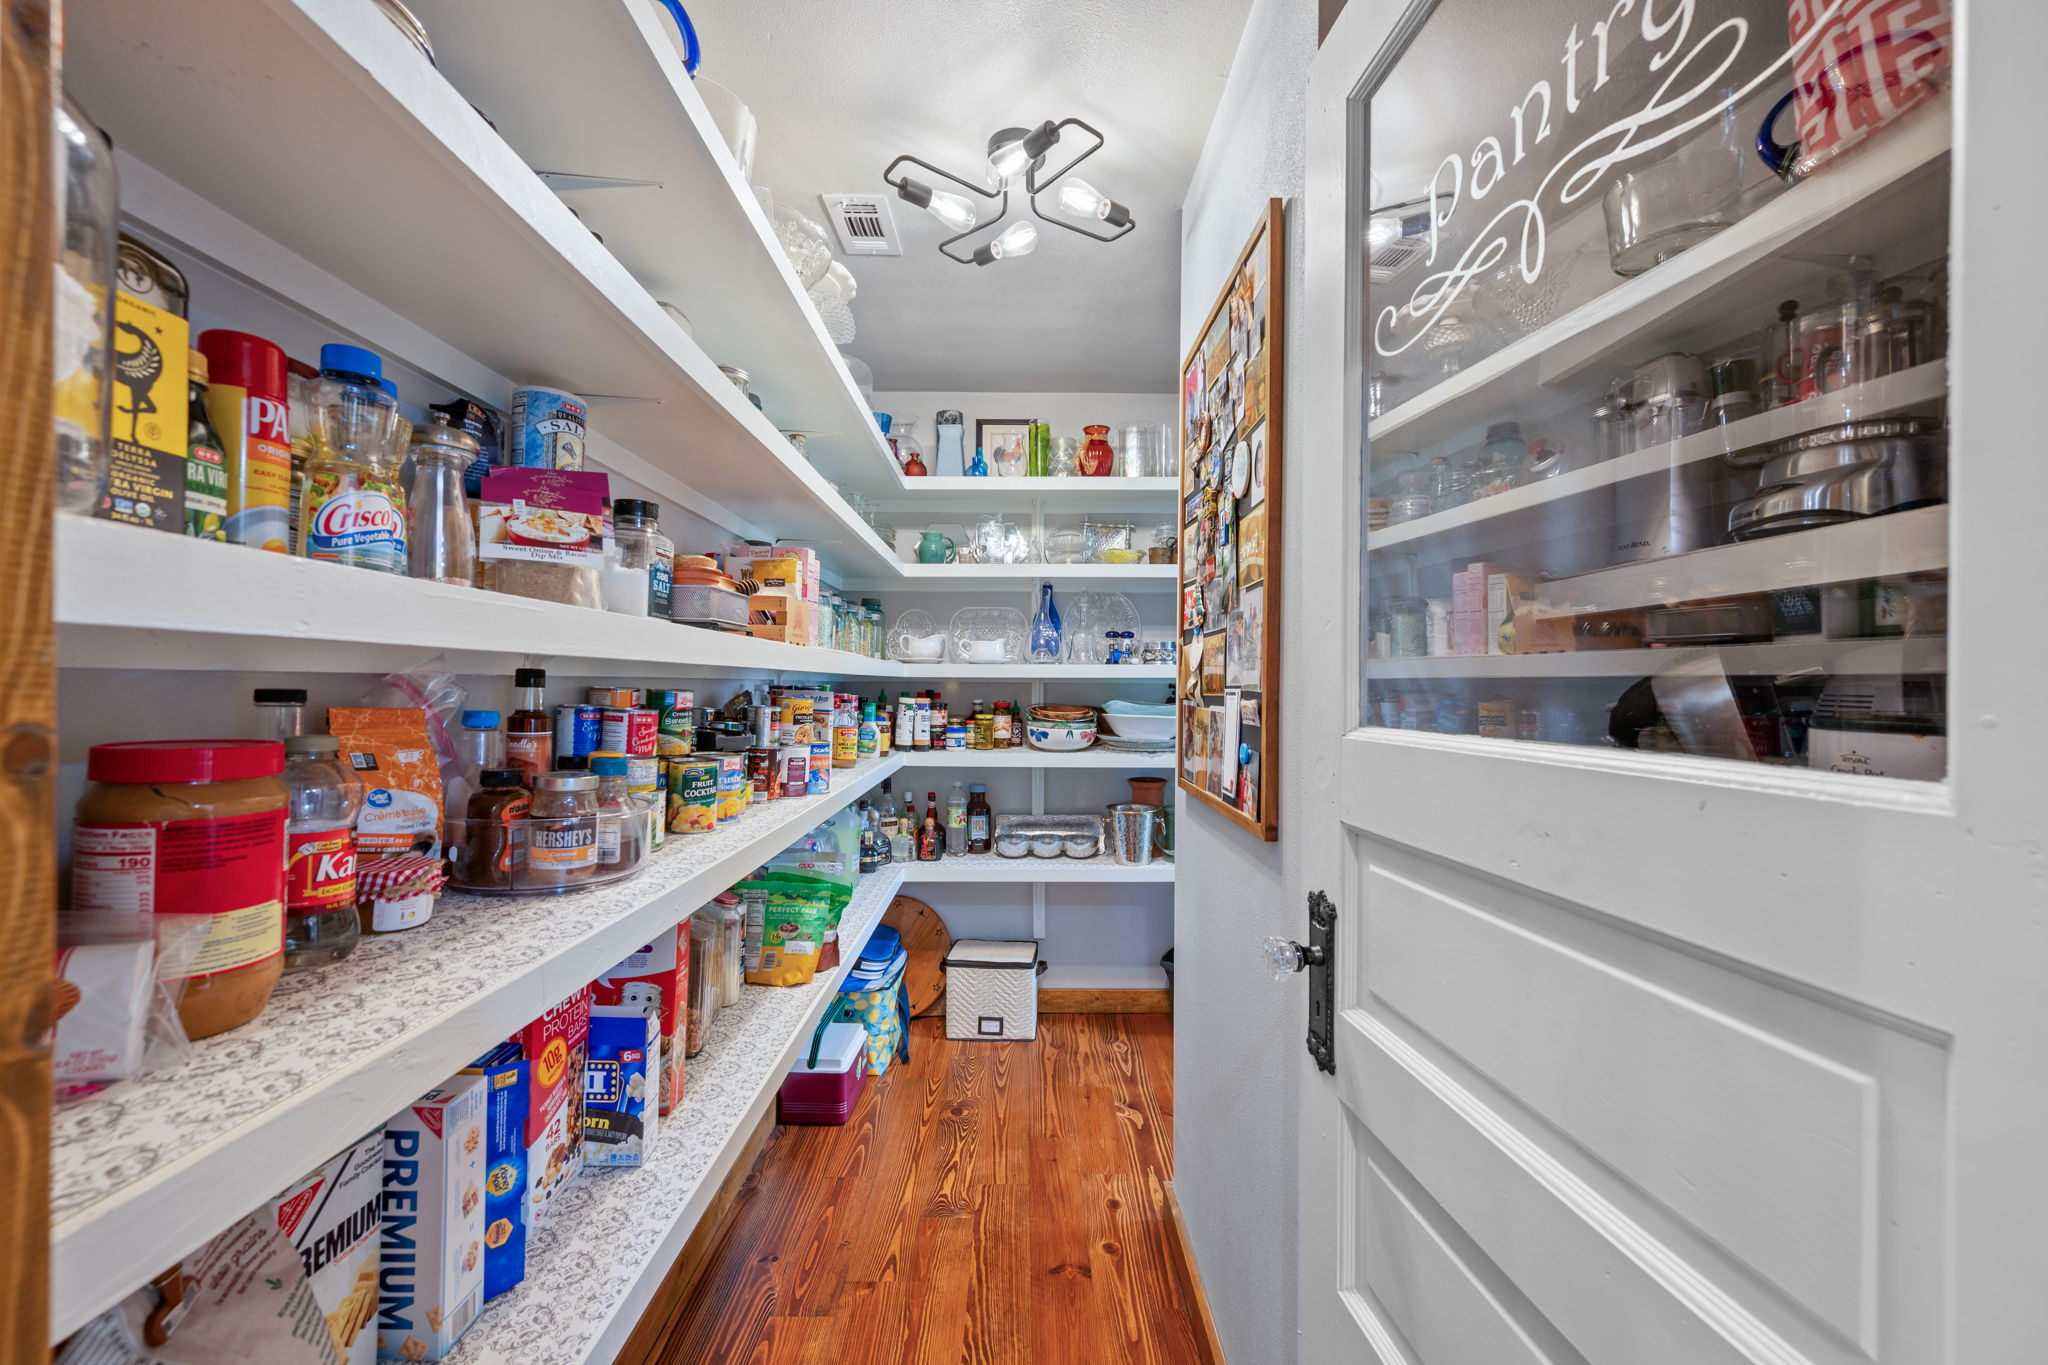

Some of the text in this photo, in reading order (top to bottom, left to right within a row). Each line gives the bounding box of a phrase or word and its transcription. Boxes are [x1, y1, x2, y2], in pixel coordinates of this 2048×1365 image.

[250, 396, 290, 444] PA
[117, 442, 152, 457] TERRA
[110, 470, 156, 486] ORGANIC
[208, 467, 228, 490] VIR
[110, 487, 138, 500] OLIVE
[132, 482, 174, 500] VIRGIN
[323, 503, 390, 536] Crisco
[331, 536, 353, 548] Pure
[502, 544, 527, 552] Sweet
[528, 547, 554, 557] Onion
[565, 551, 588, 559] Bacon
[531, 551, 563, 561] Dip Mix
[653, 580, 671, 594] SALT
[692, 779, 714, 788] FRUIT
[536, 828, 593, 848] HERSHEY'S
[119, 857, 151, 868] 190
[315, 852, 357, 882] Ka
[543, 1000, 587, 1042] PROTEIN
[568, 1013, 587, 1038] BARS
[542, 1044, 562, 1072] 10g
[623, 1051, 632, 1062] 6
[546, 1118, 560, 1140] 42
[584, 1116, 610, 1130] orn
[365, 1144, 376, 1155] The
[339, 1171, 360, 1190] Family
[492, 1173, 501, 1192] Maid
[499, 1166, 510, 1190] Honey
[299, 1192, 382, 1278] REMIUM
[378, 1130, 420, 1331] PREMIUM
[231, 1228, 268, 1267] grains
